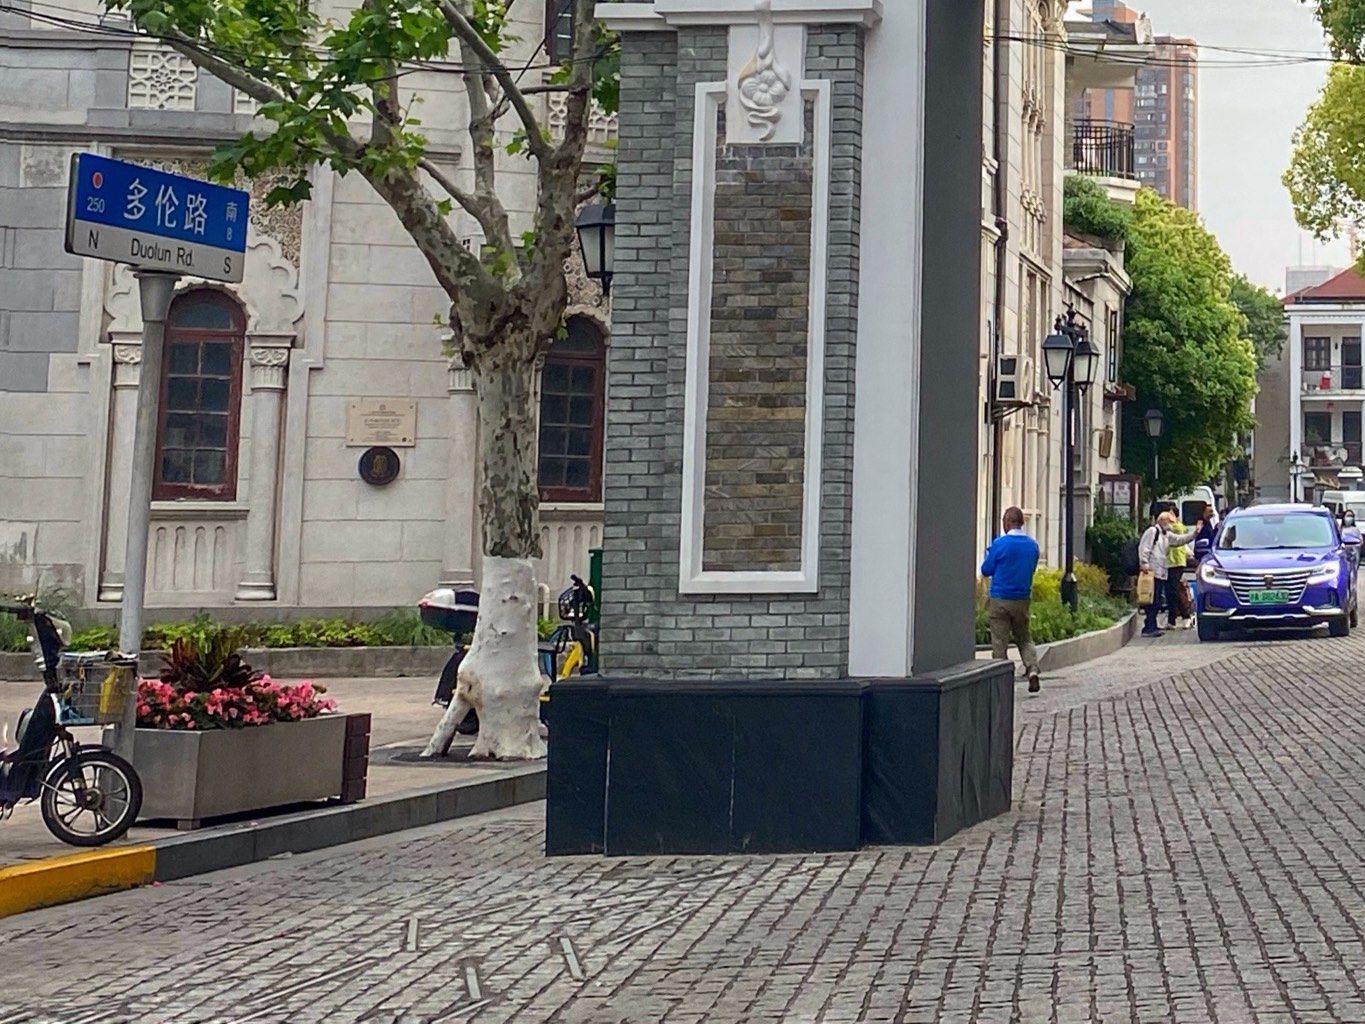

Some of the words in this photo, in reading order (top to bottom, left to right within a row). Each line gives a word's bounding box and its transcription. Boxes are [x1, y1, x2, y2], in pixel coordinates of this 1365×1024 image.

[86, 196, 106, 214] 250
[123, 177, 208, 236] 多伦路
[225, 201, 239, 223] 南
[88, 229, 100, 250] N
[130, 237, 172, 262] Duolun
[223, 256, 232, 274] S
